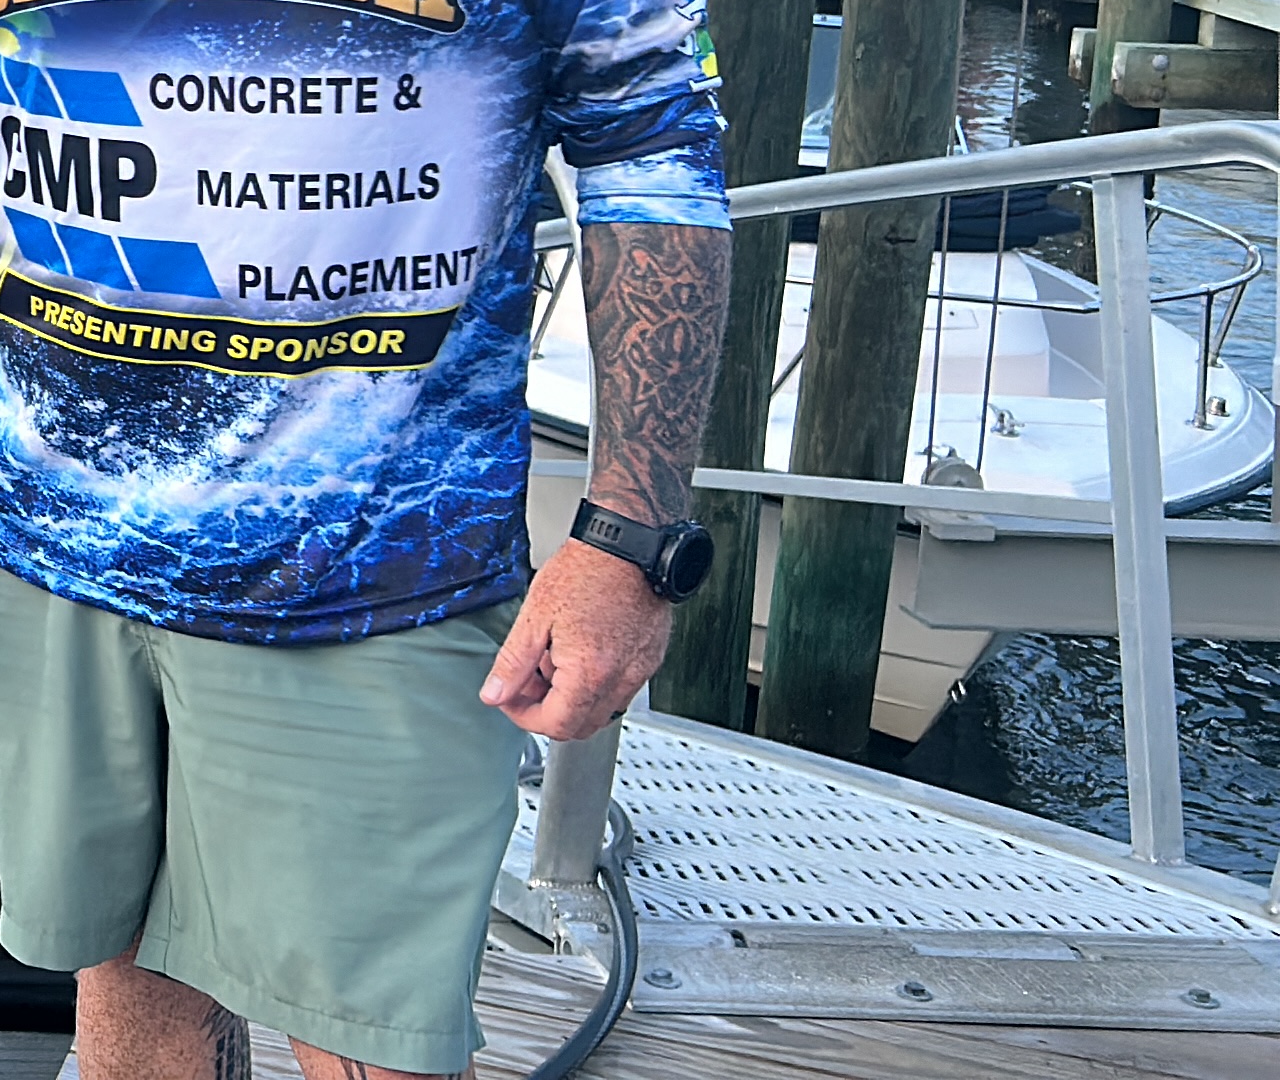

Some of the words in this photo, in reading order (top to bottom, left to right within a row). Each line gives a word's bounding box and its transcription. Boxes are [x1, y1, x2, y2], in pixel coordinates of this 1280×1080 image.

[148, 72, 379, 115] CONCRETE
[393, 72, 422, 110] &
[0, 115, 157, 223] CMP
[196, 163, 441, 212] MATERIALS
[237, 245, 478, 302] PLACEMENT
[28, 294, 218, 356] PRESENTING
[226, 328, 408, 363] SPONSOR
